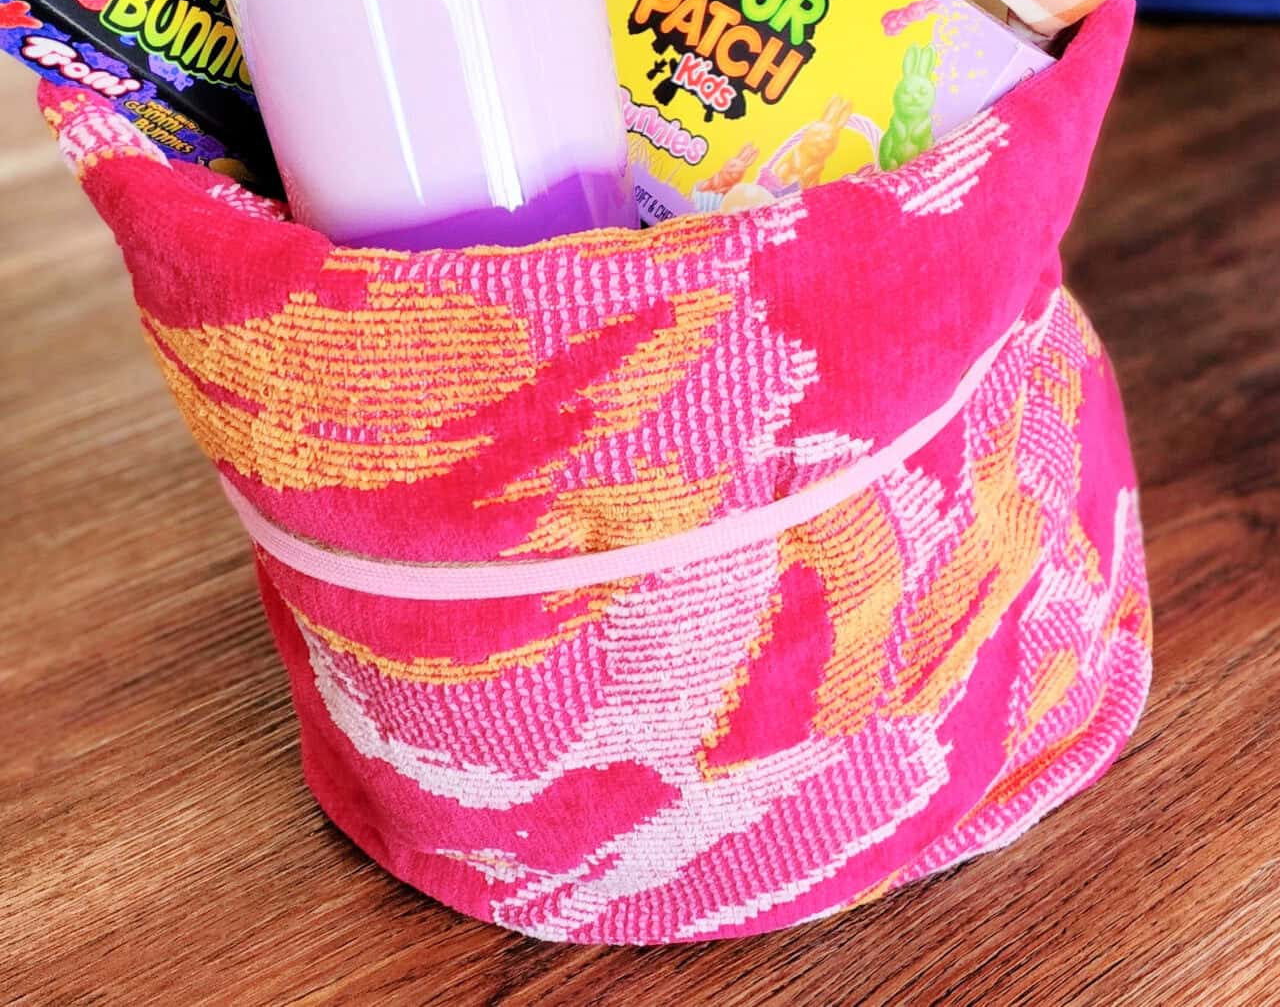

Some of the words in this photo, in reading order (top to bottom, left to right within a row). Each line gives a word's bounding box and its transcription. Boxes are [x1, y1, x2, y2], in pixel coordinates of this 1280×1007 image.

[21, 35, 141, 97] Trolli
[671, 52, 737, 111] Kids
[124, 100, 184, 133] GUMMI
[135, 117, 195, 153] BUNNIES
[620, 85, 709, 166] unnies
